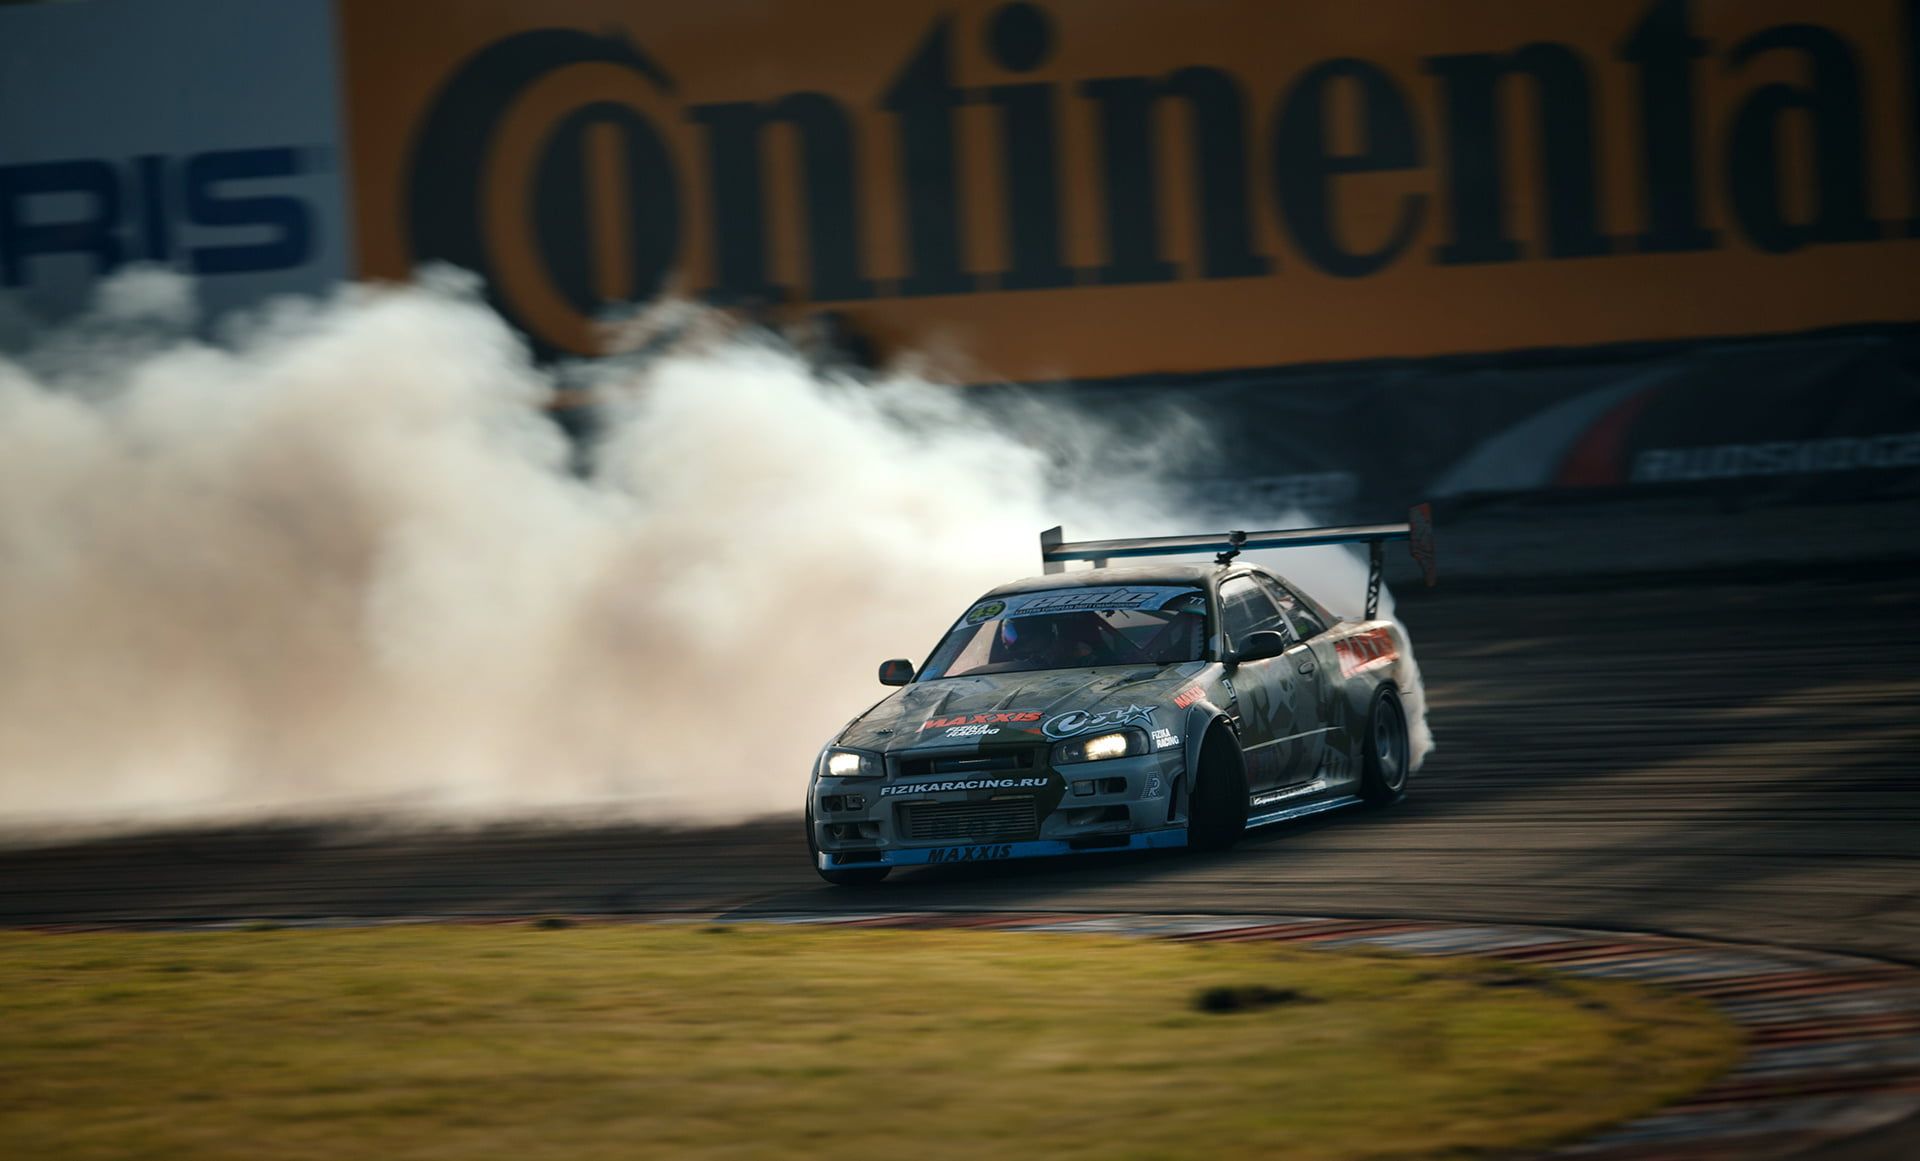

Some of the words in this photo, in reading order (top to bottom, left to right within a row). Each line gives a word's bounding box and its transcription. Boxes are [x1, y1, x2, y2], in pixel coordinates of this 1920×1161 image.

[404, 0, 1920, 356] Continenta
[1174, 686, 1206, 710] MAXXIS
[922, 711, 1045, 731] MAXXIS
[945, 724, 989, 733] FIZIKA
[946, 728, 1001, 738] RACING
[1151, 728, 1171, 740] FIZIKA
[1156, 735, 1180, 749] RACING
[880, 777, 1049, 796] FIZIKARACING.RU
[928, 844, 1012, 864] MAXXIS
